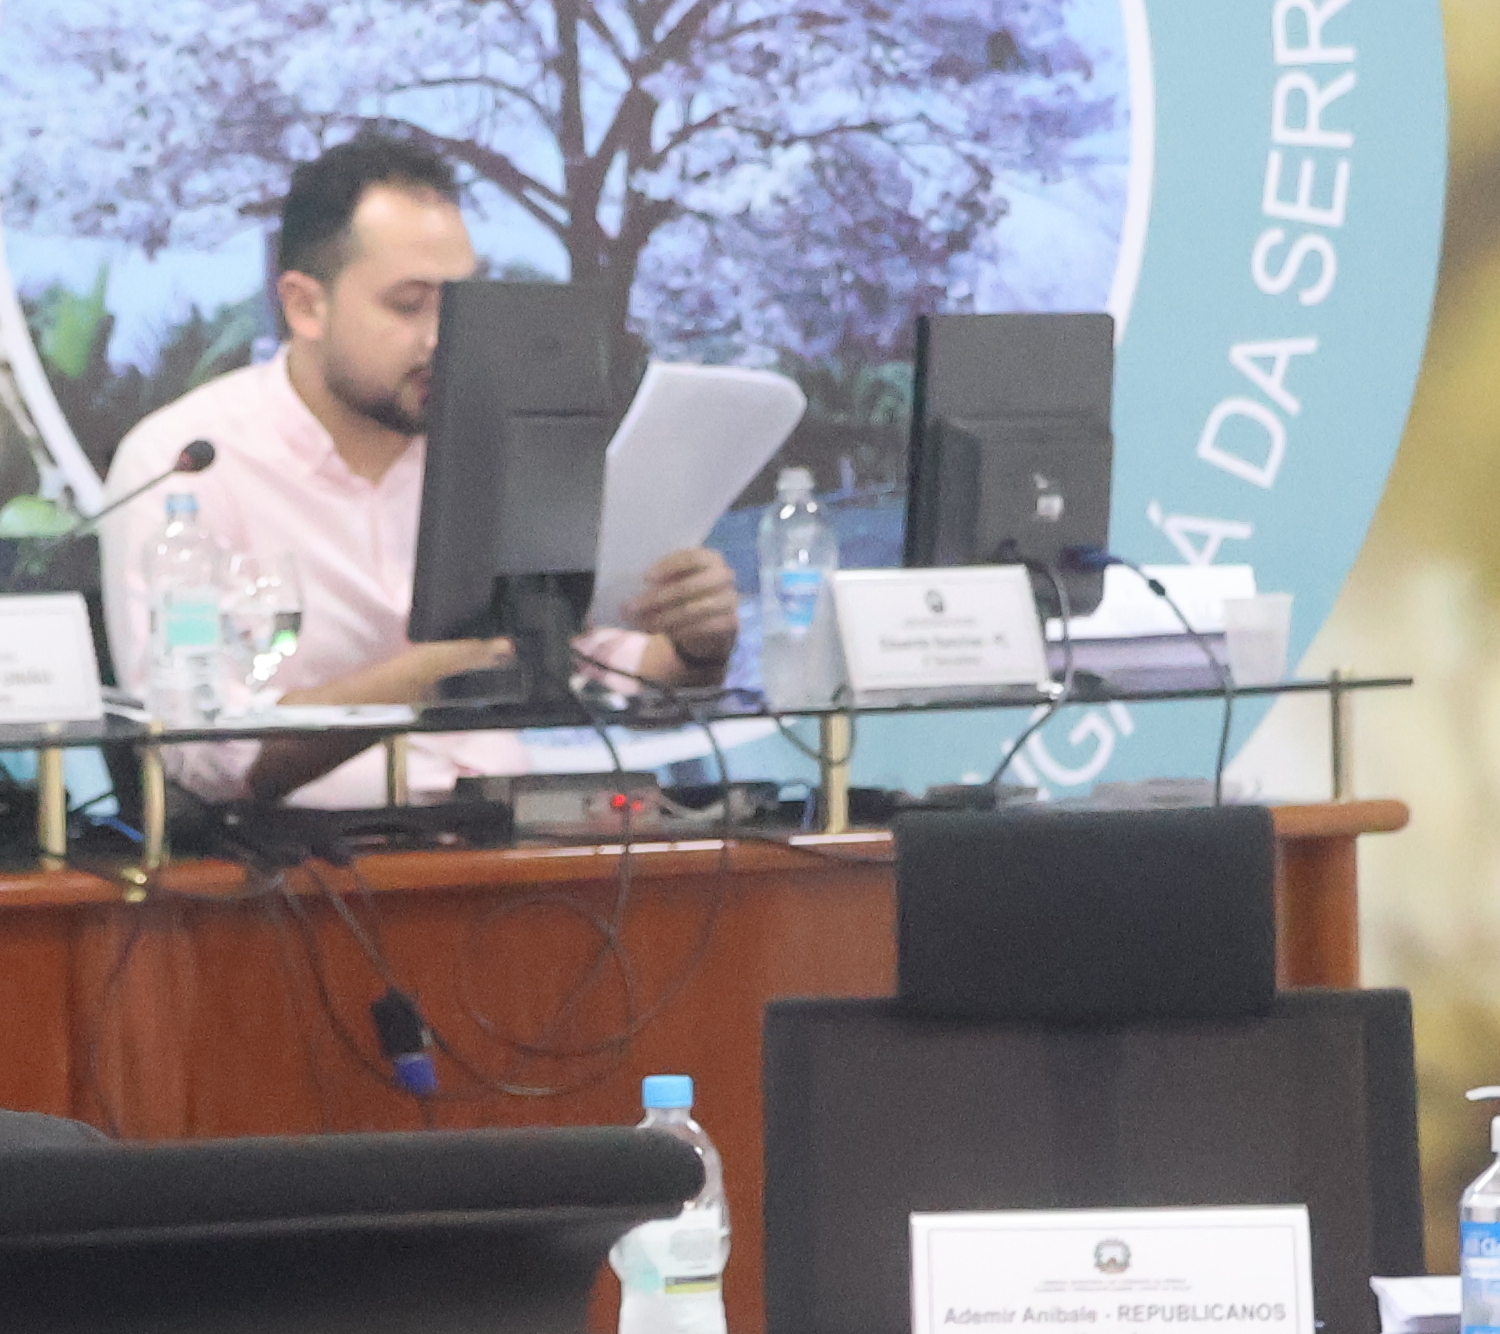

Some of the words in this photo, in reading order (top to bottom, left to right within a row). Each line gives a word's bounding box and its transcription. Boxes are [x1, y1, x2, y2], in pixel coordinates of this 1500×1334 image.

[1198, 335, 1320, 491] DA
[944, 1306, 1015, 1325] Ademir
[1022, 1306, 1097, 1324] Anibale
[1117, 1302, 1287, 1322] REPUBLICANOS
